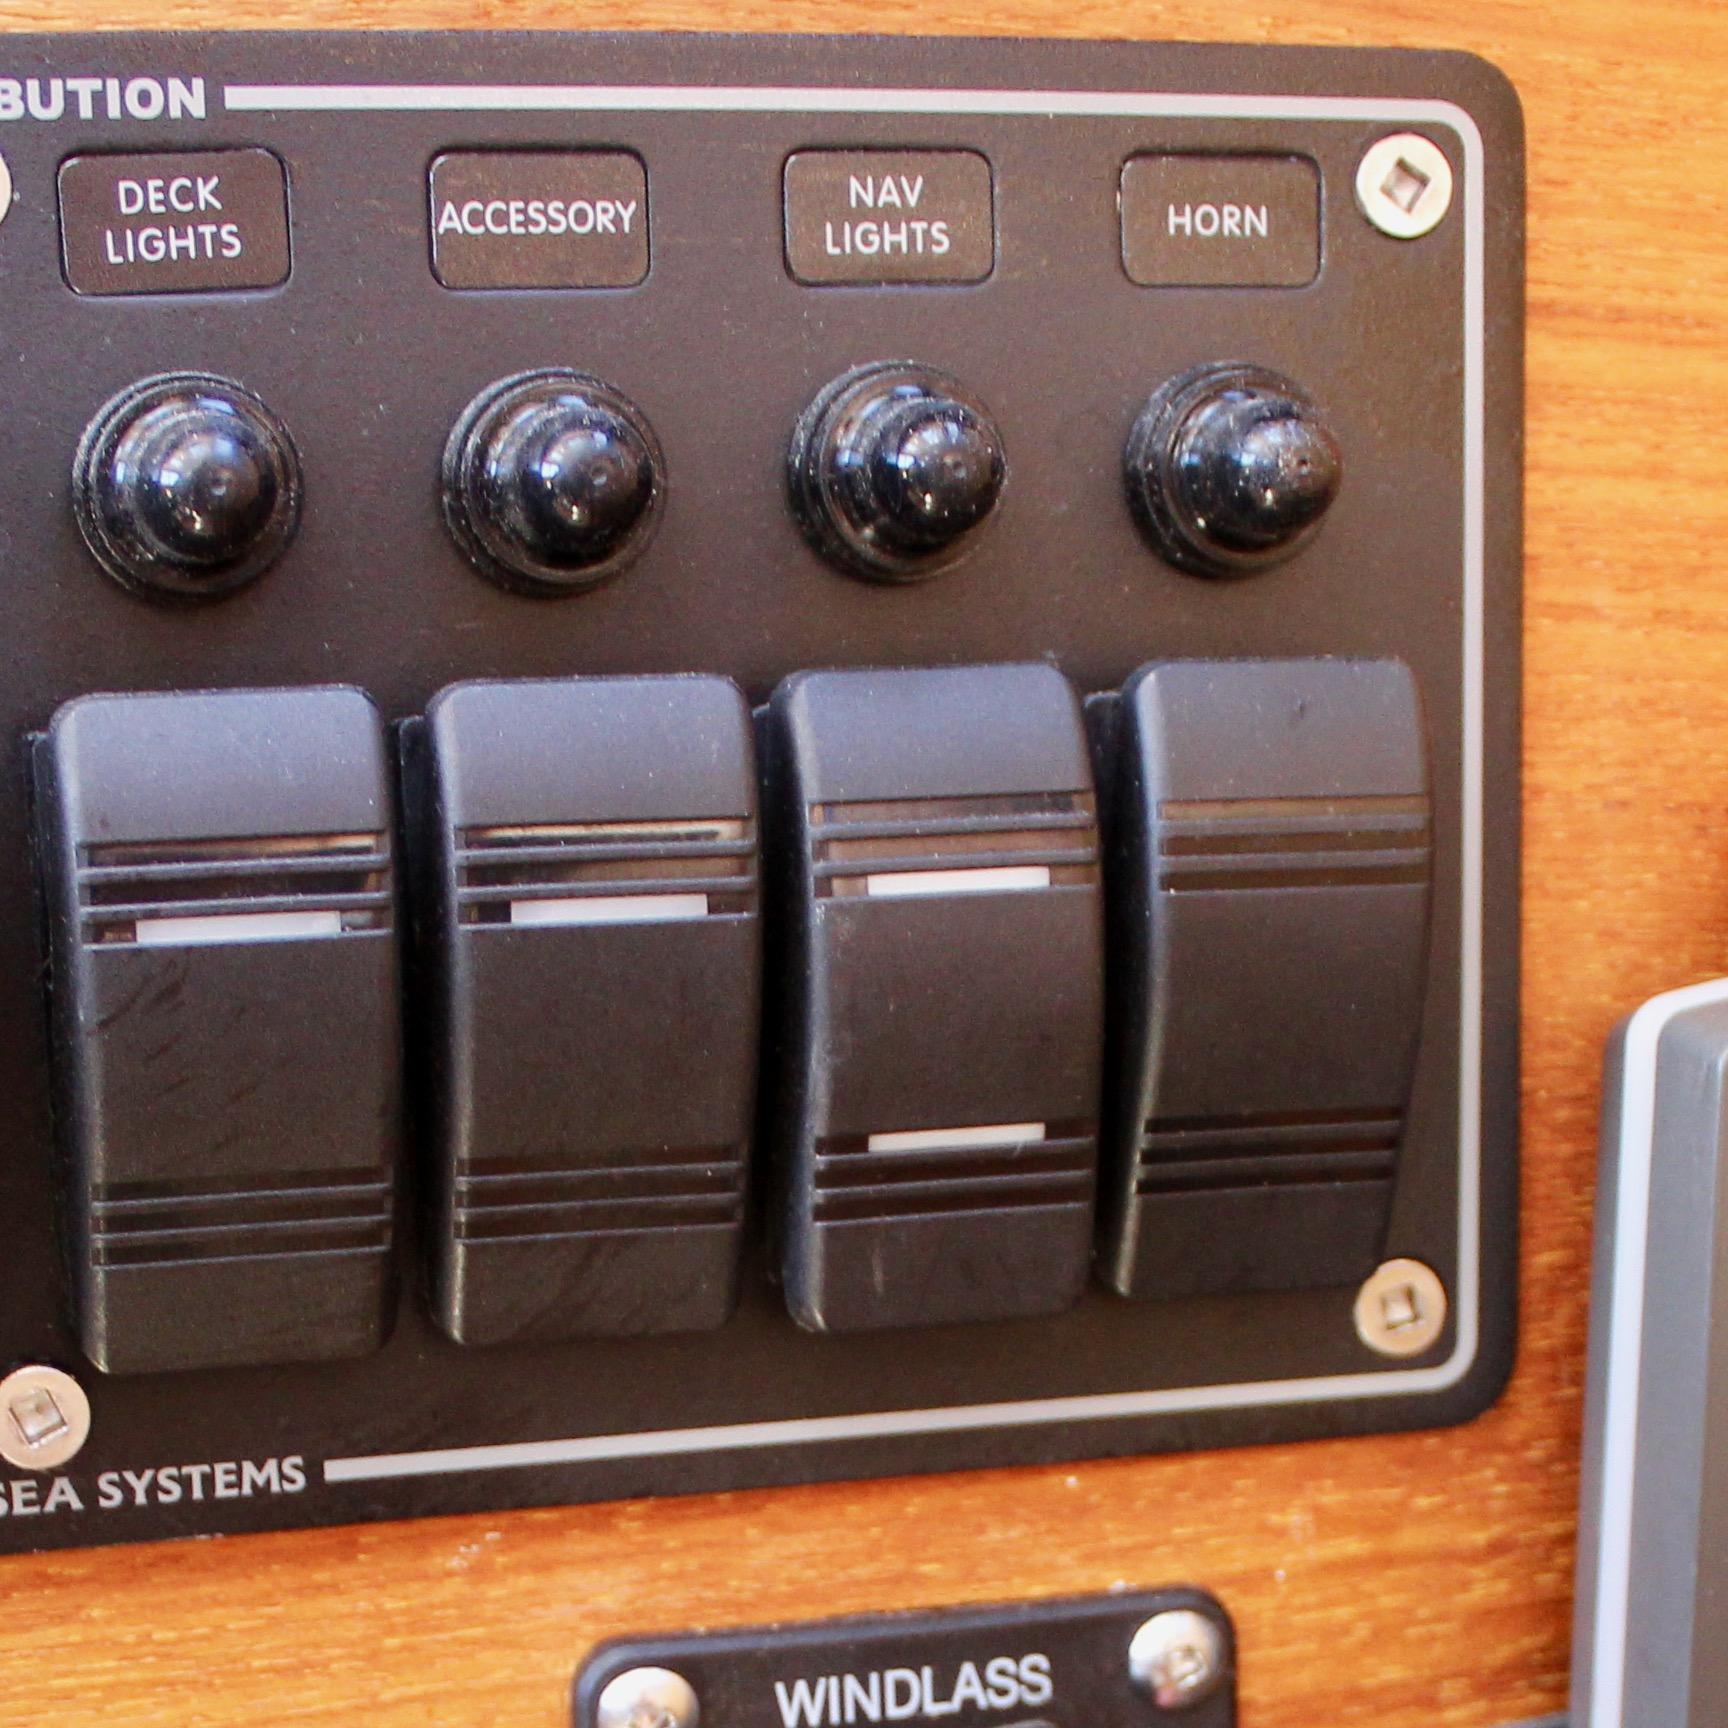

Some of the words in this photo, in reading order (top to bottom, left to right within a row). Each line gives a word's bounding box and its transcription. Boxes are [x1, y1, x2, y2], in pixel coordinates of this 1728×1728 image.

[117, 175, 223, 216] DECK
[848, 174, 925, 210] NAV
[437, 200, 636, 237] ACCESSORY
[1166, 203, 1269, 239] HORN
[104, 222, 243, 265] LIGHTS
[825, 220, 951, 256] LIGHTS
[96, 1455, 307, 1509] SYSTEMS
